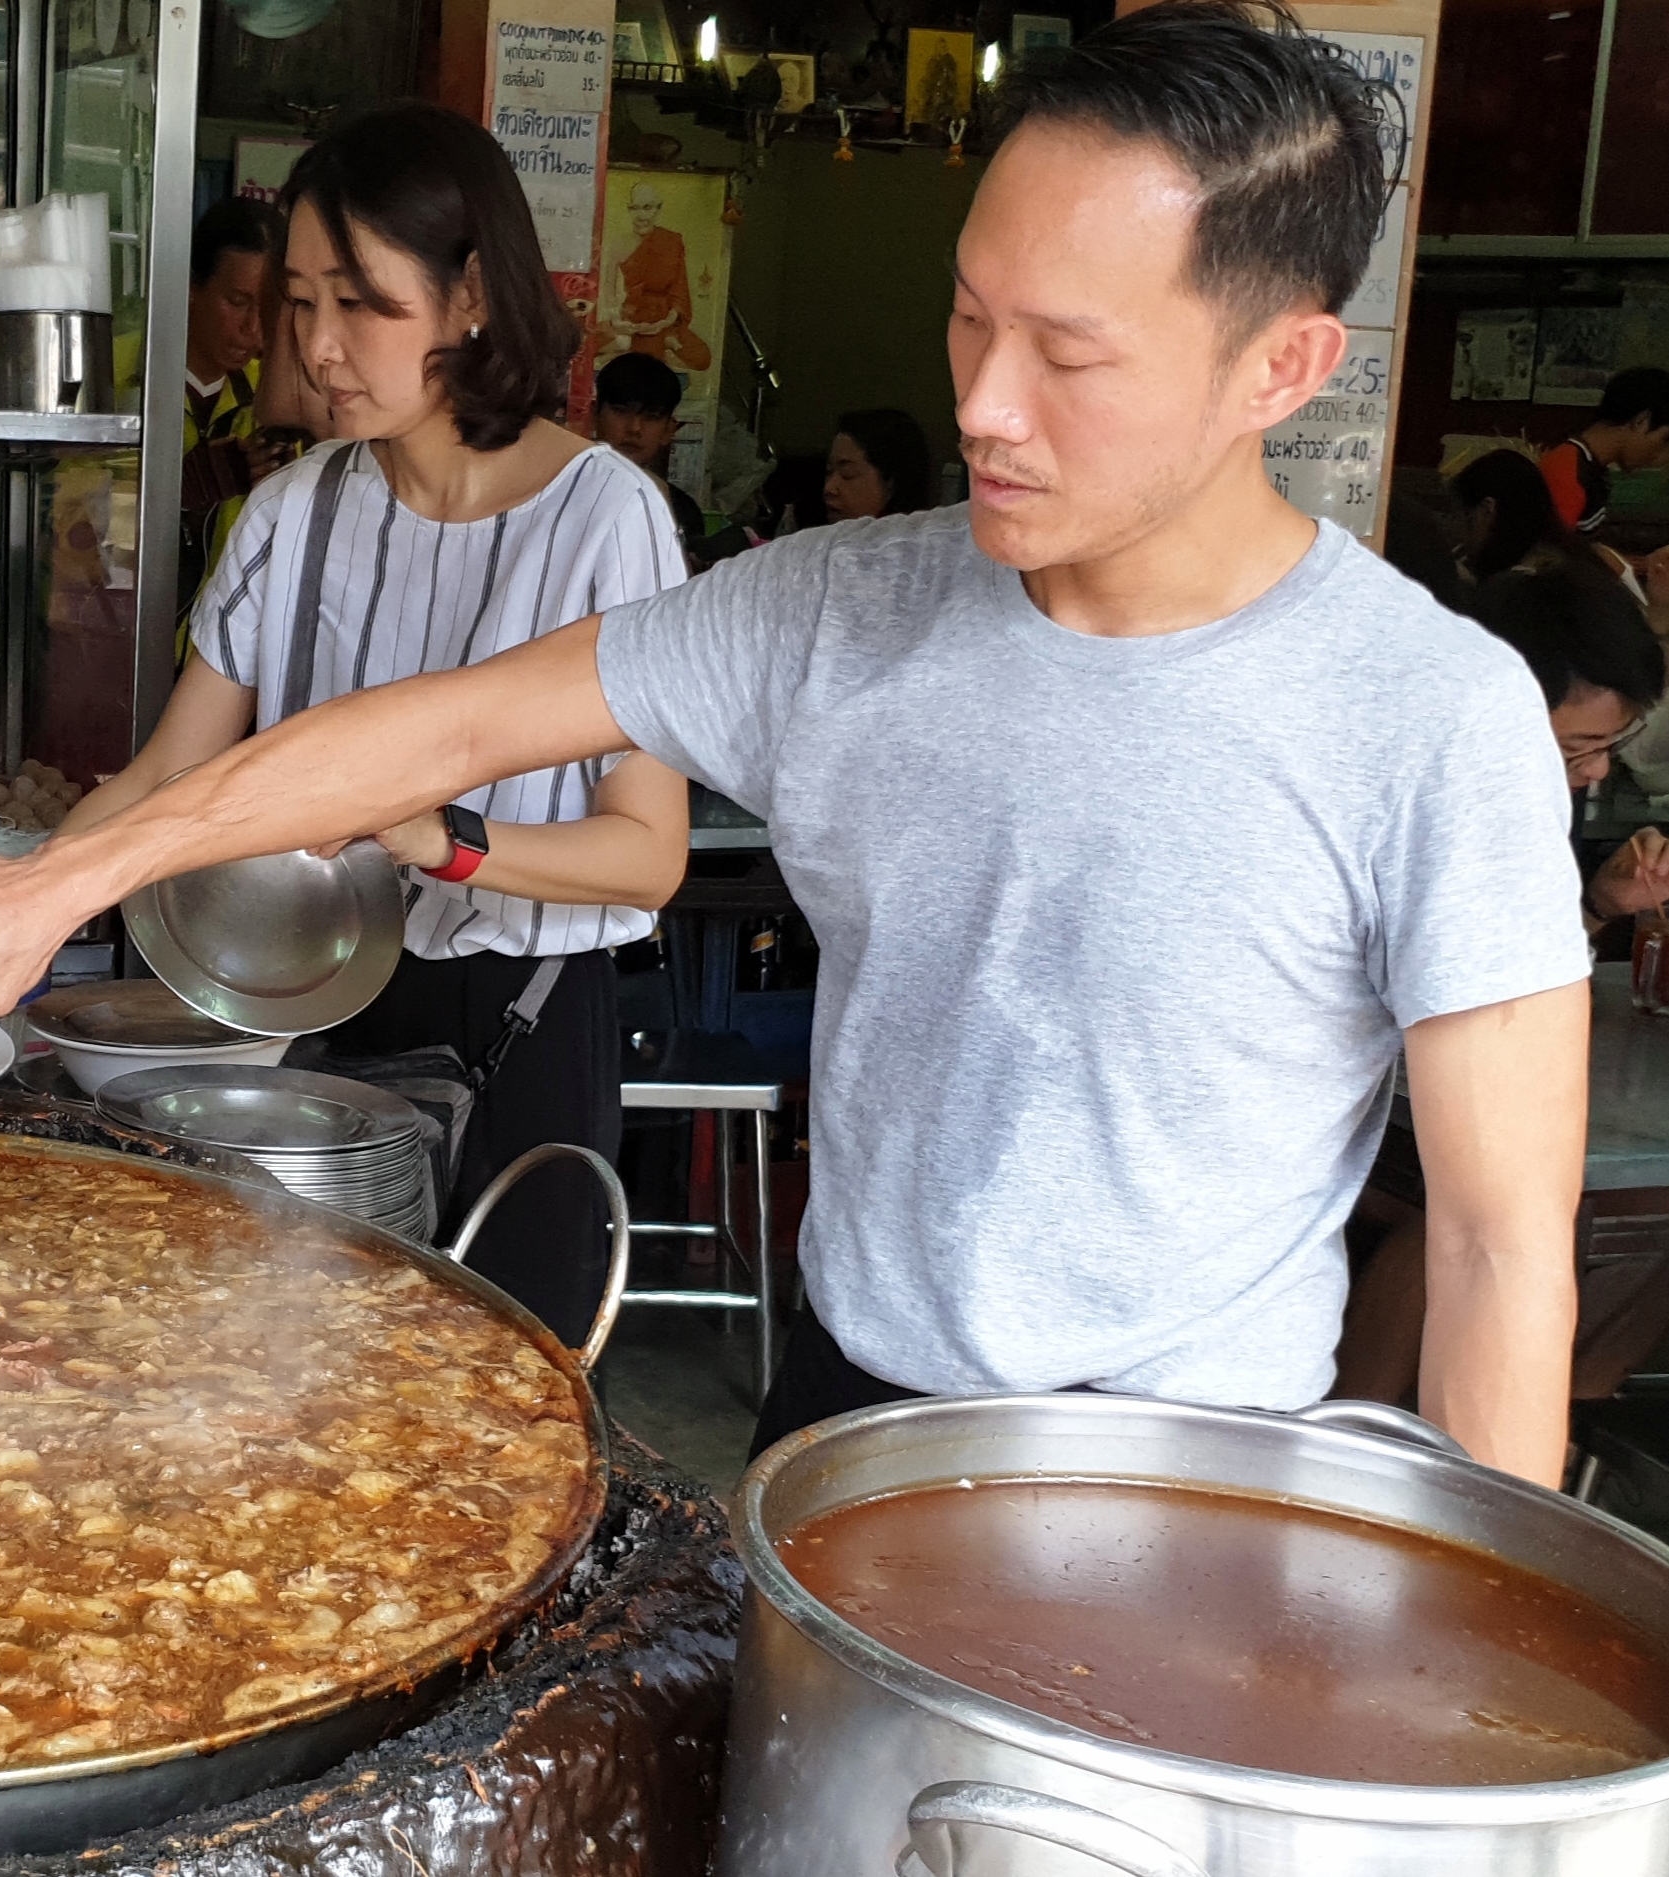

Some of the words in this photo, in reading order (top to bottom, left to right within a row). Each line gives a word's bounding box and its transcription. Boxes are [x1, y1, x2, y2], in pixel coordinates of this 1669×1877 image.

[496, 106, 592, 140] ตัวเดียวแพะ
